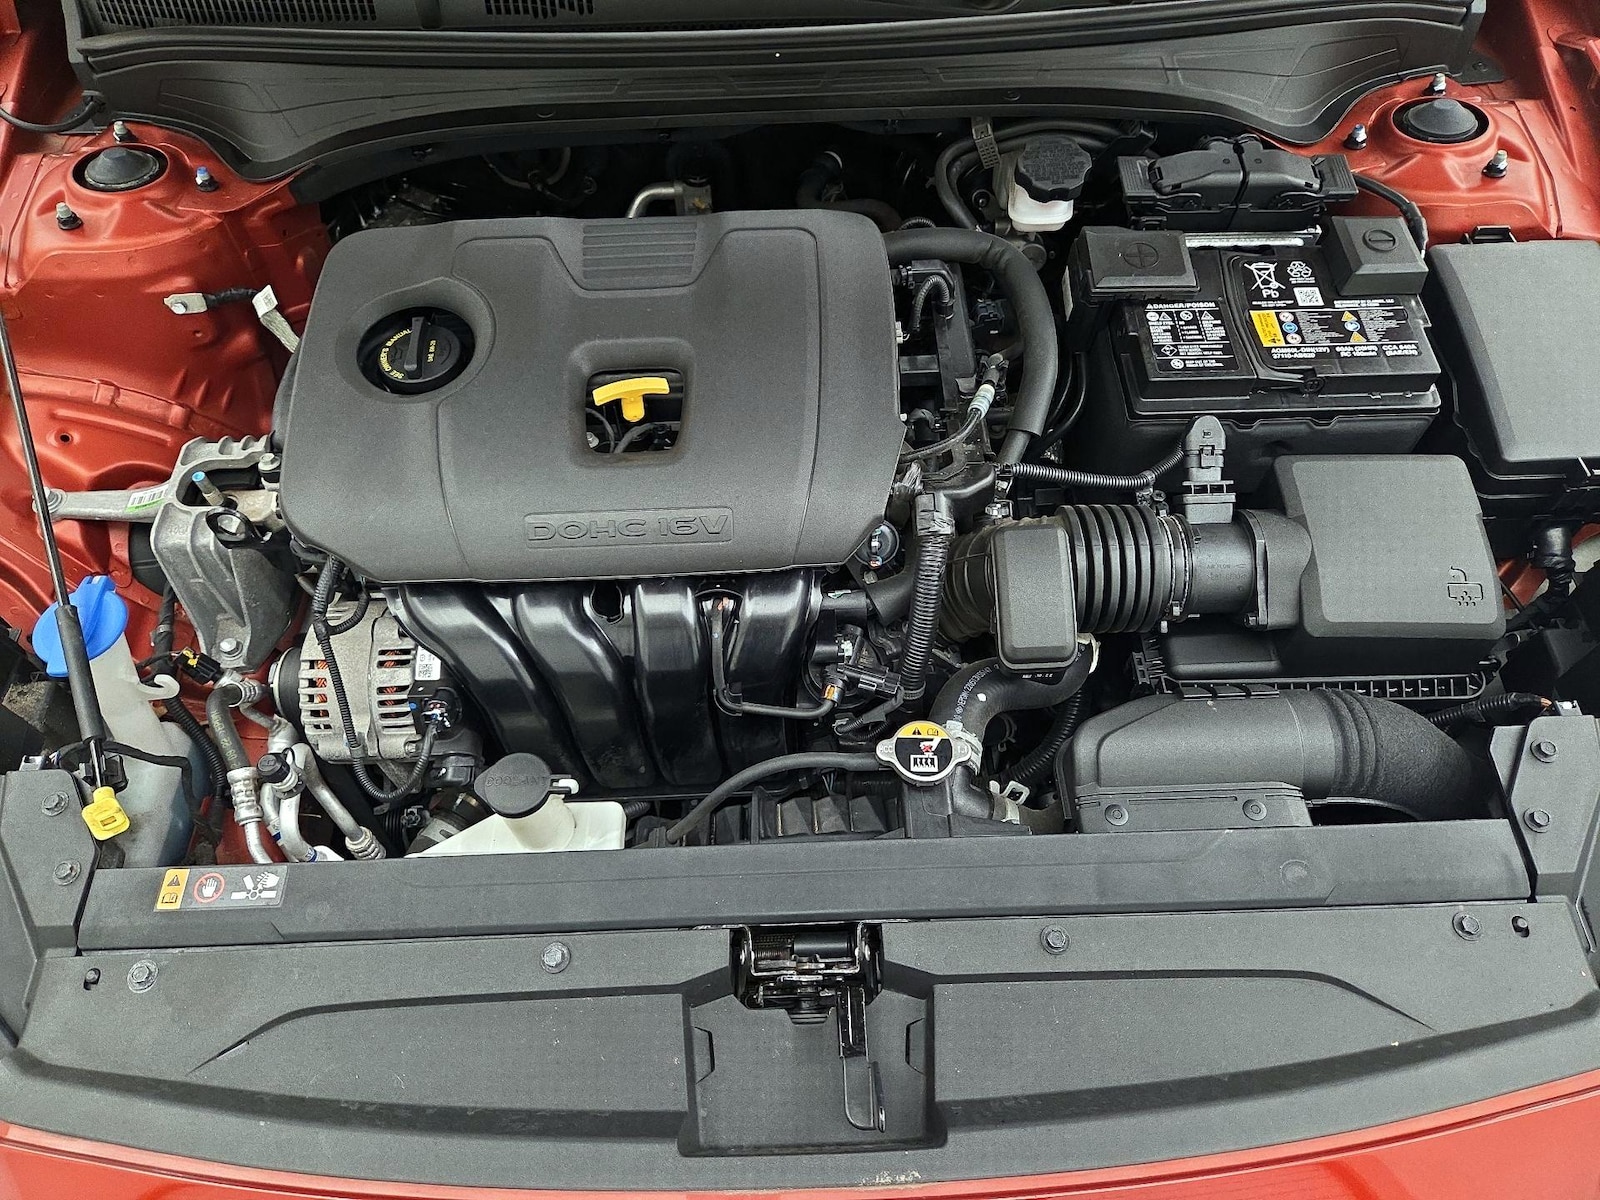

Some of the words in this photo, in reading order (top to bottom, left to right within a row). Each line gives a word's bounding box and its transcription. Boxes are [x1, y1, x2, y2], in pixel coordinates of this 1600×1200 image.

[1262, 289, 1279, 298] Pb
[385, 329, 413, 346] MANUAL
[389, 370, 404, 379] SEE
[528, 518, 646, 541] DOHC
[658, 515, 728, 537] 16V
[486, 775, 548, 787] COOLANT
